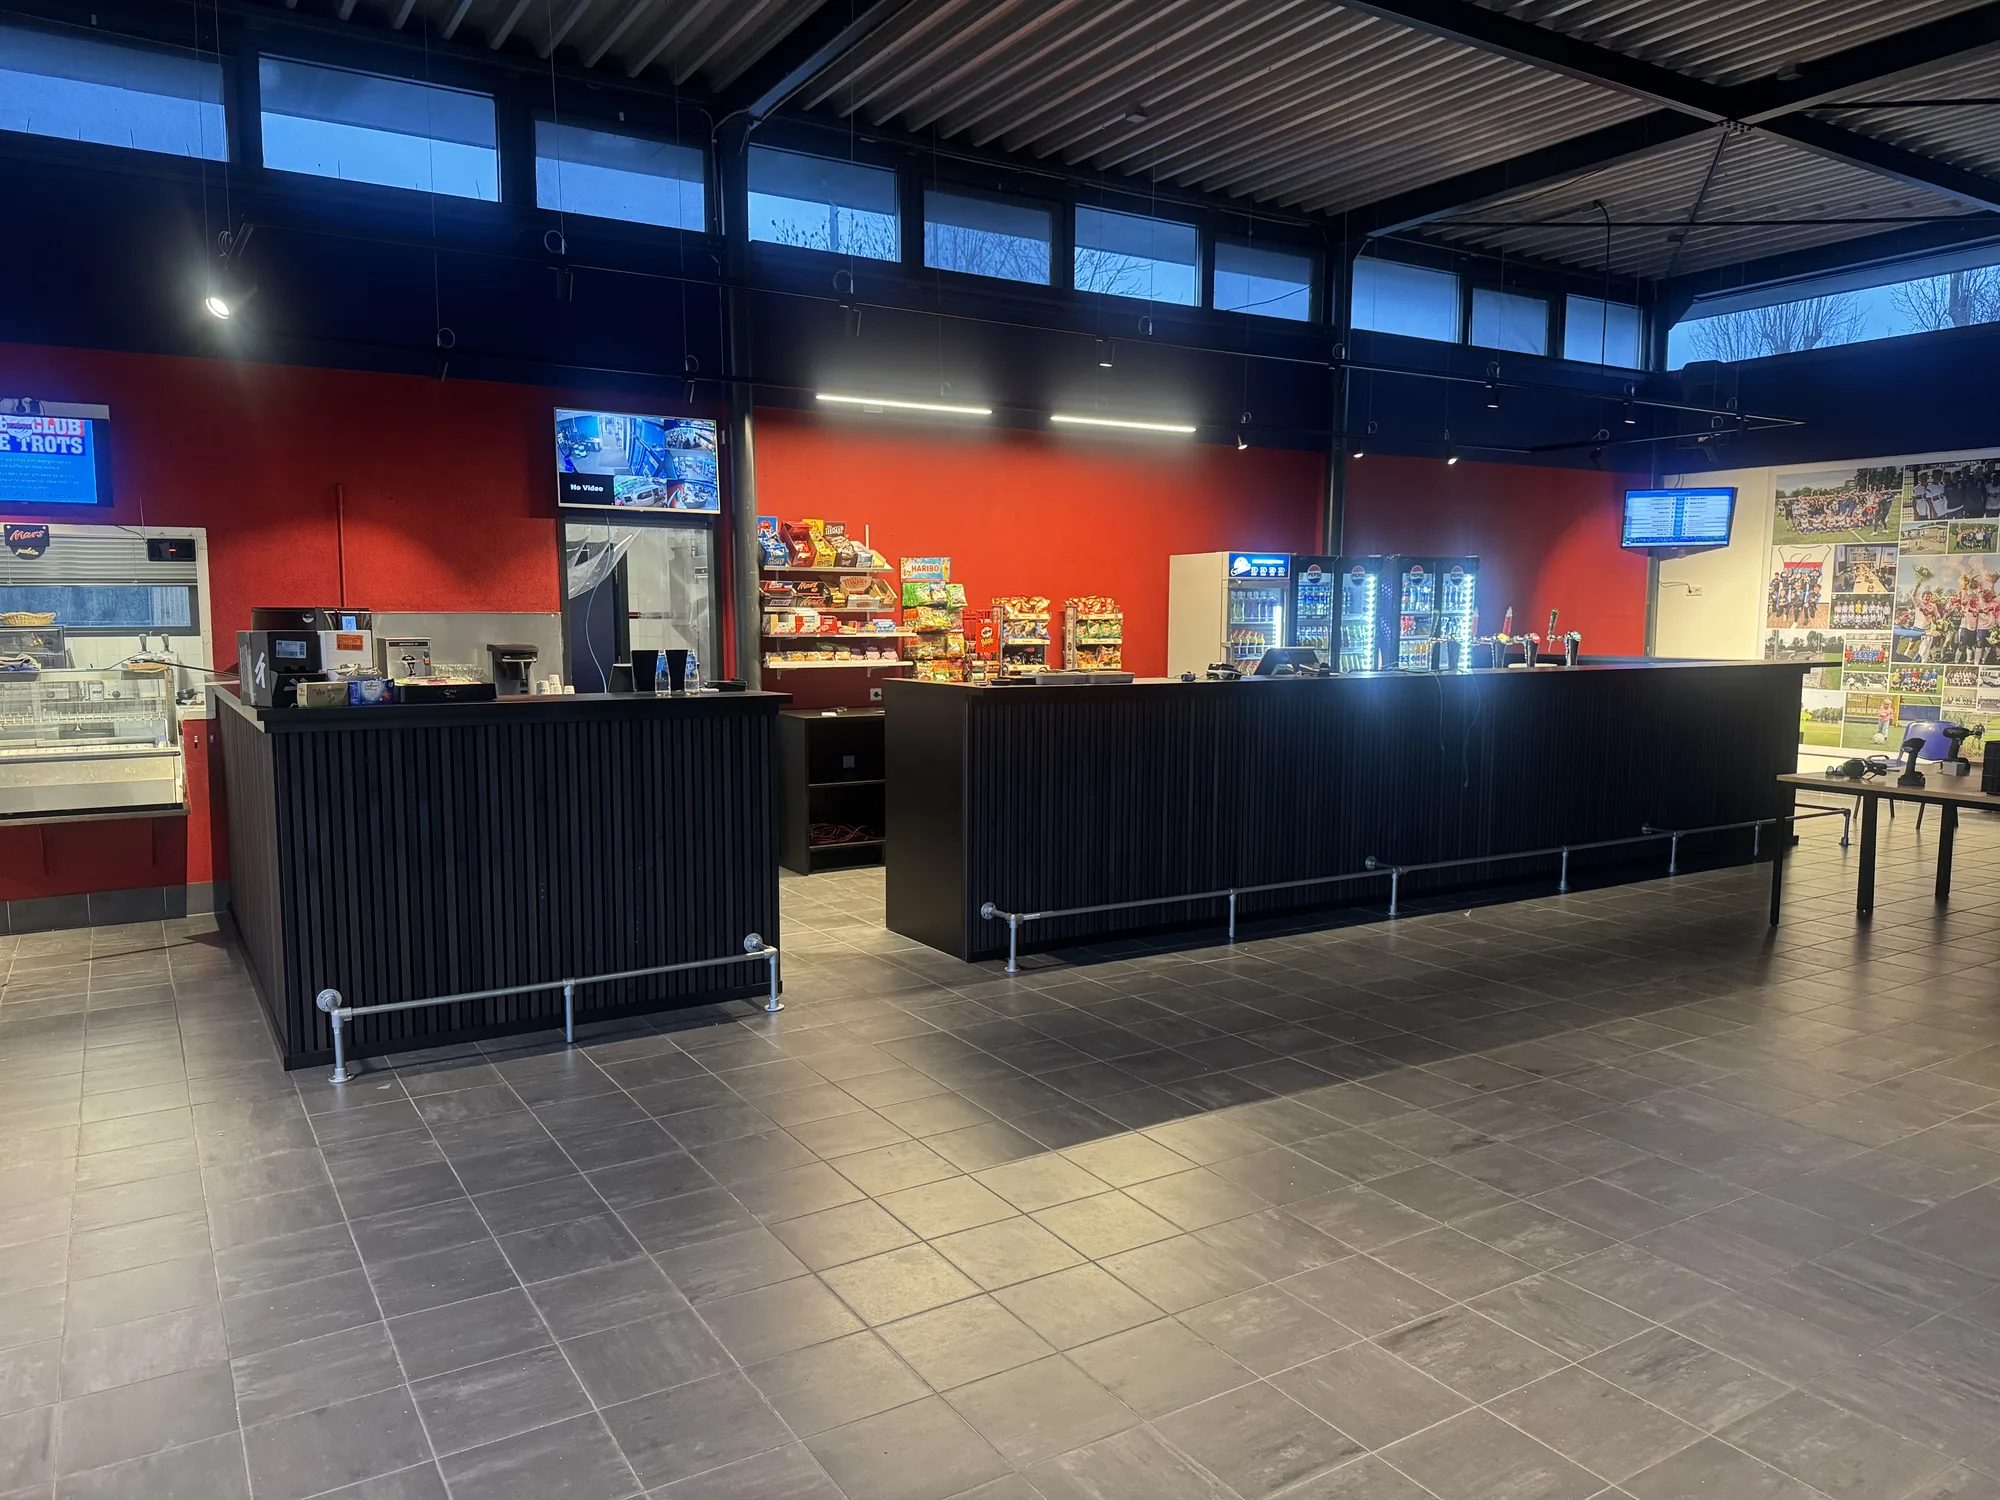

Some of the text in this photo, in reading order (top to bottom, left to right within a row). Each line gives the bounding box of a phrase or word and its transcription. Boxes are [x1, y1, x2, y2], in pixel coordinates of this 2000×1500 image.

[32, 417, 81, 435] CLUB
[17, 435, 83, 454] TROTS
[10, 530, 45, 541] Mars
[911, 564, 940, 573] HARIBO
[797, 581, 819, 590] Mars
[800, 597, 825, 607] Mars
